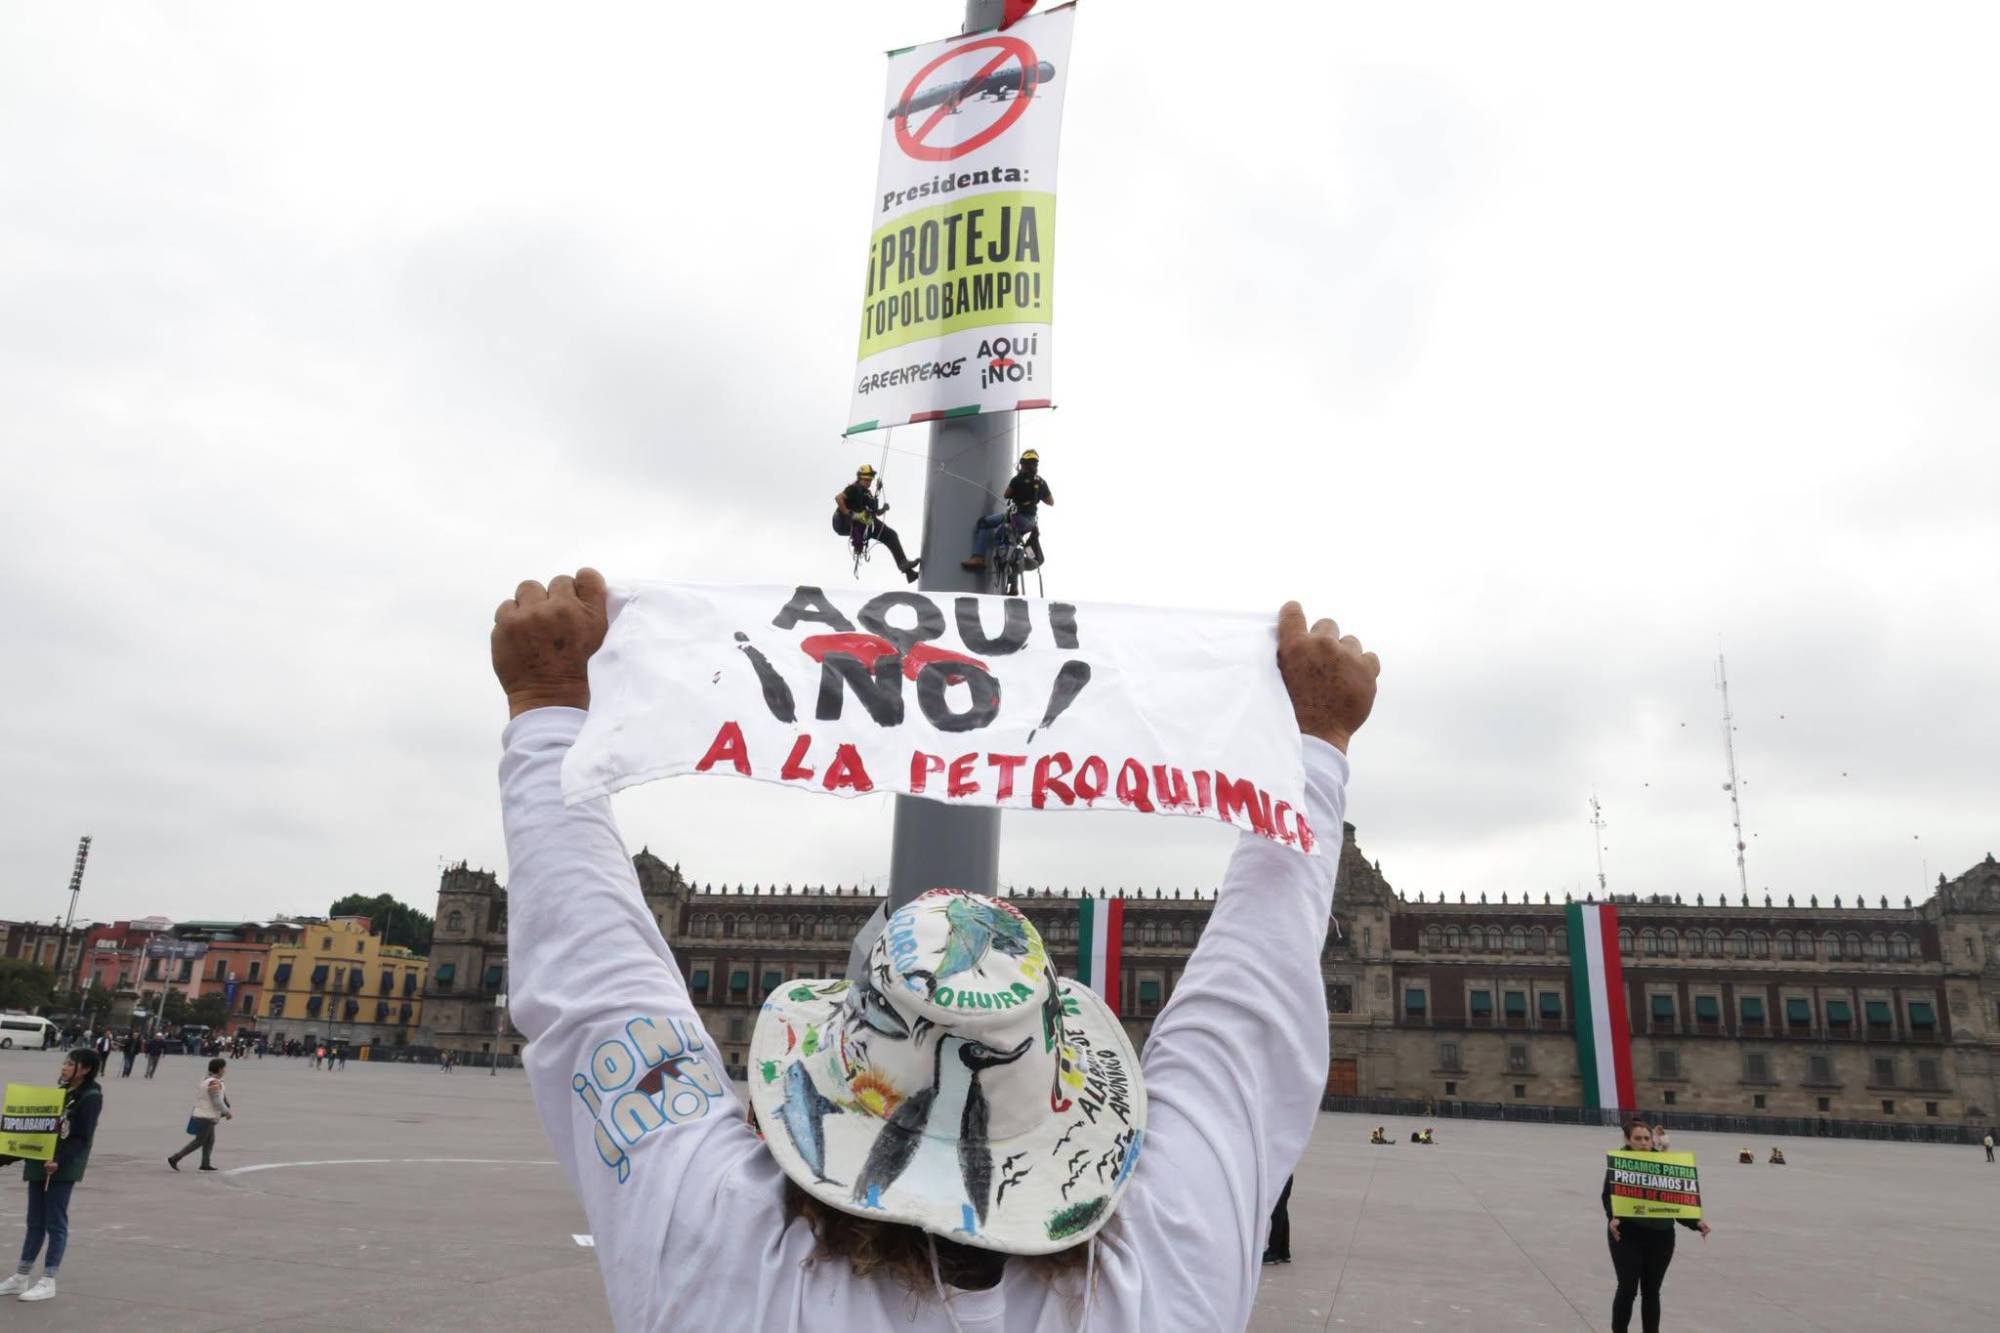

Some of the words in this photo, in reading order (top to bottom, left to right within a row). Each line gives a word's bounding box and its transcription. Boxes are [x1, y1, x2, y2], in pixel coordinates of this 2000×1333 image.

[882, 166, 1030, 213] Presidenta:
[867, 205, 1041, 298] ¡PROTEJA
[865, 271, 1041, 340] TOPOLOBAMPO!
[976, 332, 1039, 362] AQUÍ
[857, 356, 967, 396] GREENPEACE
[980, 361, 1034, 390] ¡NO!
[695, 720, 752, 777] A
[780, 734, 875, 792] LA
[933, 981, 1035, 1010] OHUIRA
[1096, 1049, 1132, 1126] AMONIACO
[1613, 1170, 1682, 1191] PROTEJAMOS
[1684, 1179, 1697, 1192] LA
[1614, 1158, 1661, 1174] HAGAMOS
[1662, 1165, 1697, 1179] PATRIA
